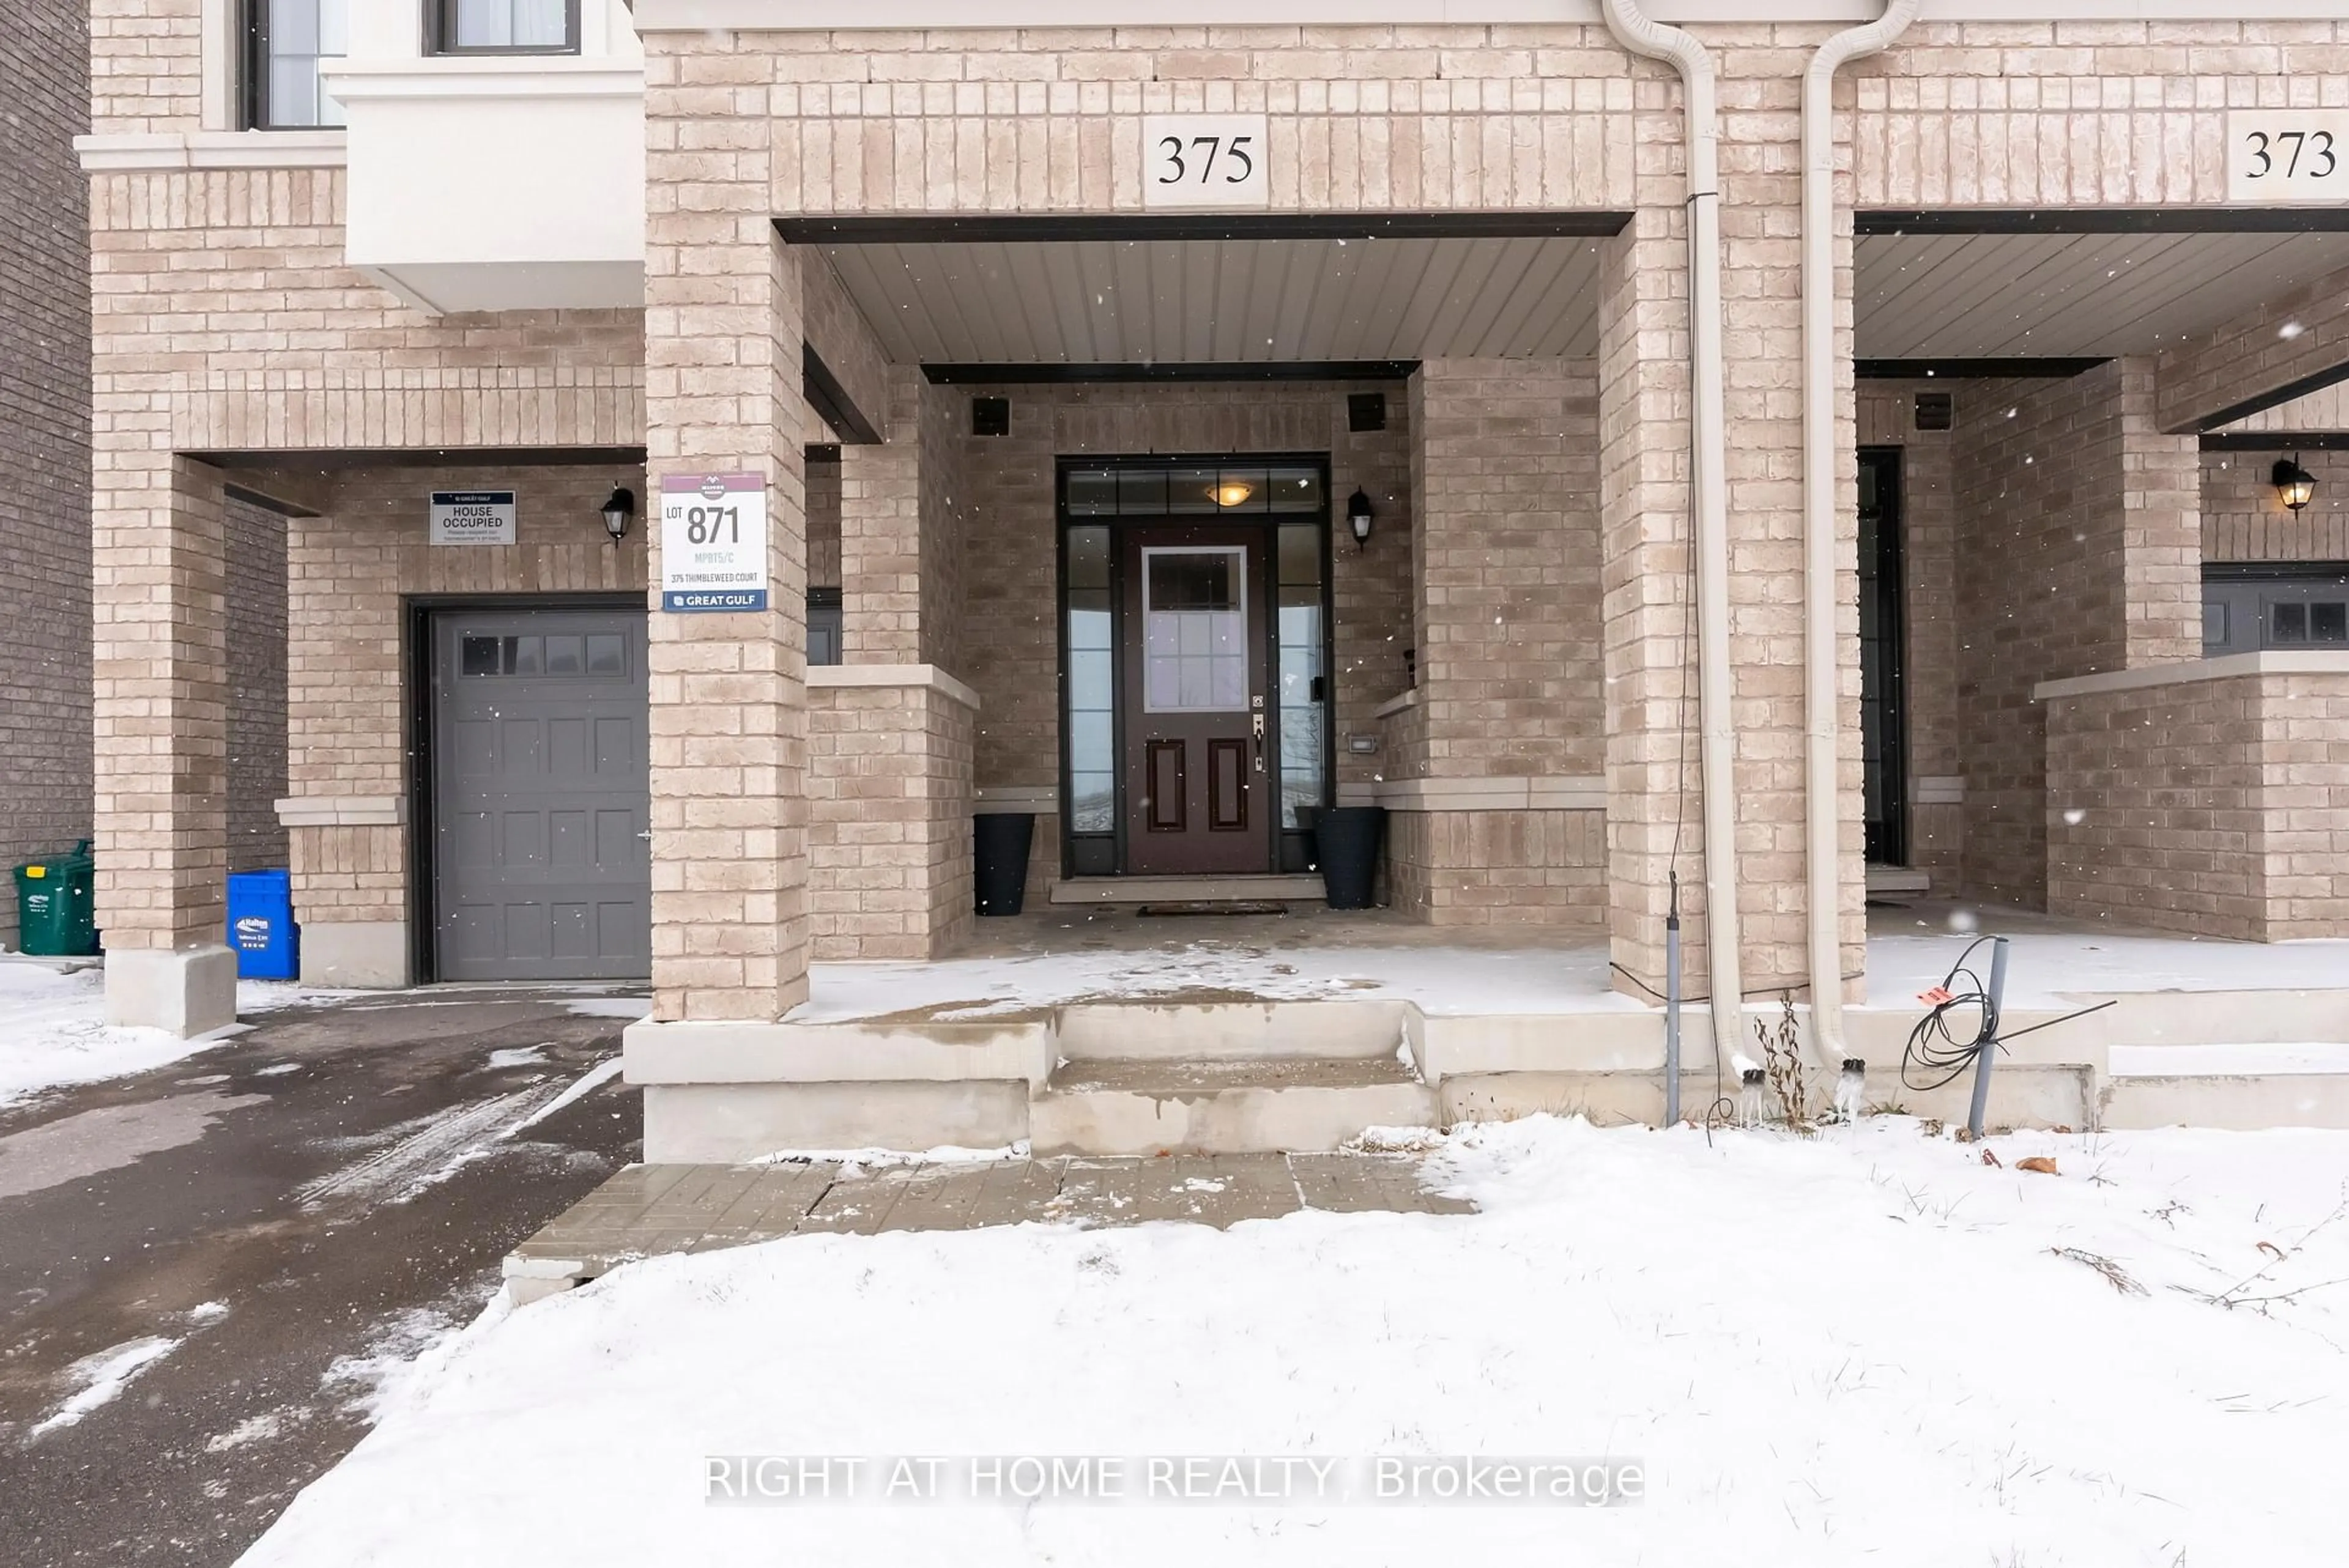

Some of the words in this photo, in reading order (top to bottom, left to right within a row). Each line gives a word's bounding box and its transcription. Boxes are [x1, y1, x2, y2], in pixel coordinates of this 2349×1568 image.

[1159, 136, 1252, 183] 375
[2245, 130, 2336, 178] 373
[453, 507, 493, 517] HOUSE
[667, 507, 683, 519] LOT
[443, 518, 503, 528] OCCUPIED
[688, 507, 738, 544] 871
[671, 574, 684, 583] 375
[685, 574, 735, 583] THIMBLEWEED
[735, 572, 757, 582] COURT
[686, 596, 724, 606] GREAT
[725, 595, 755, 605] GULF
